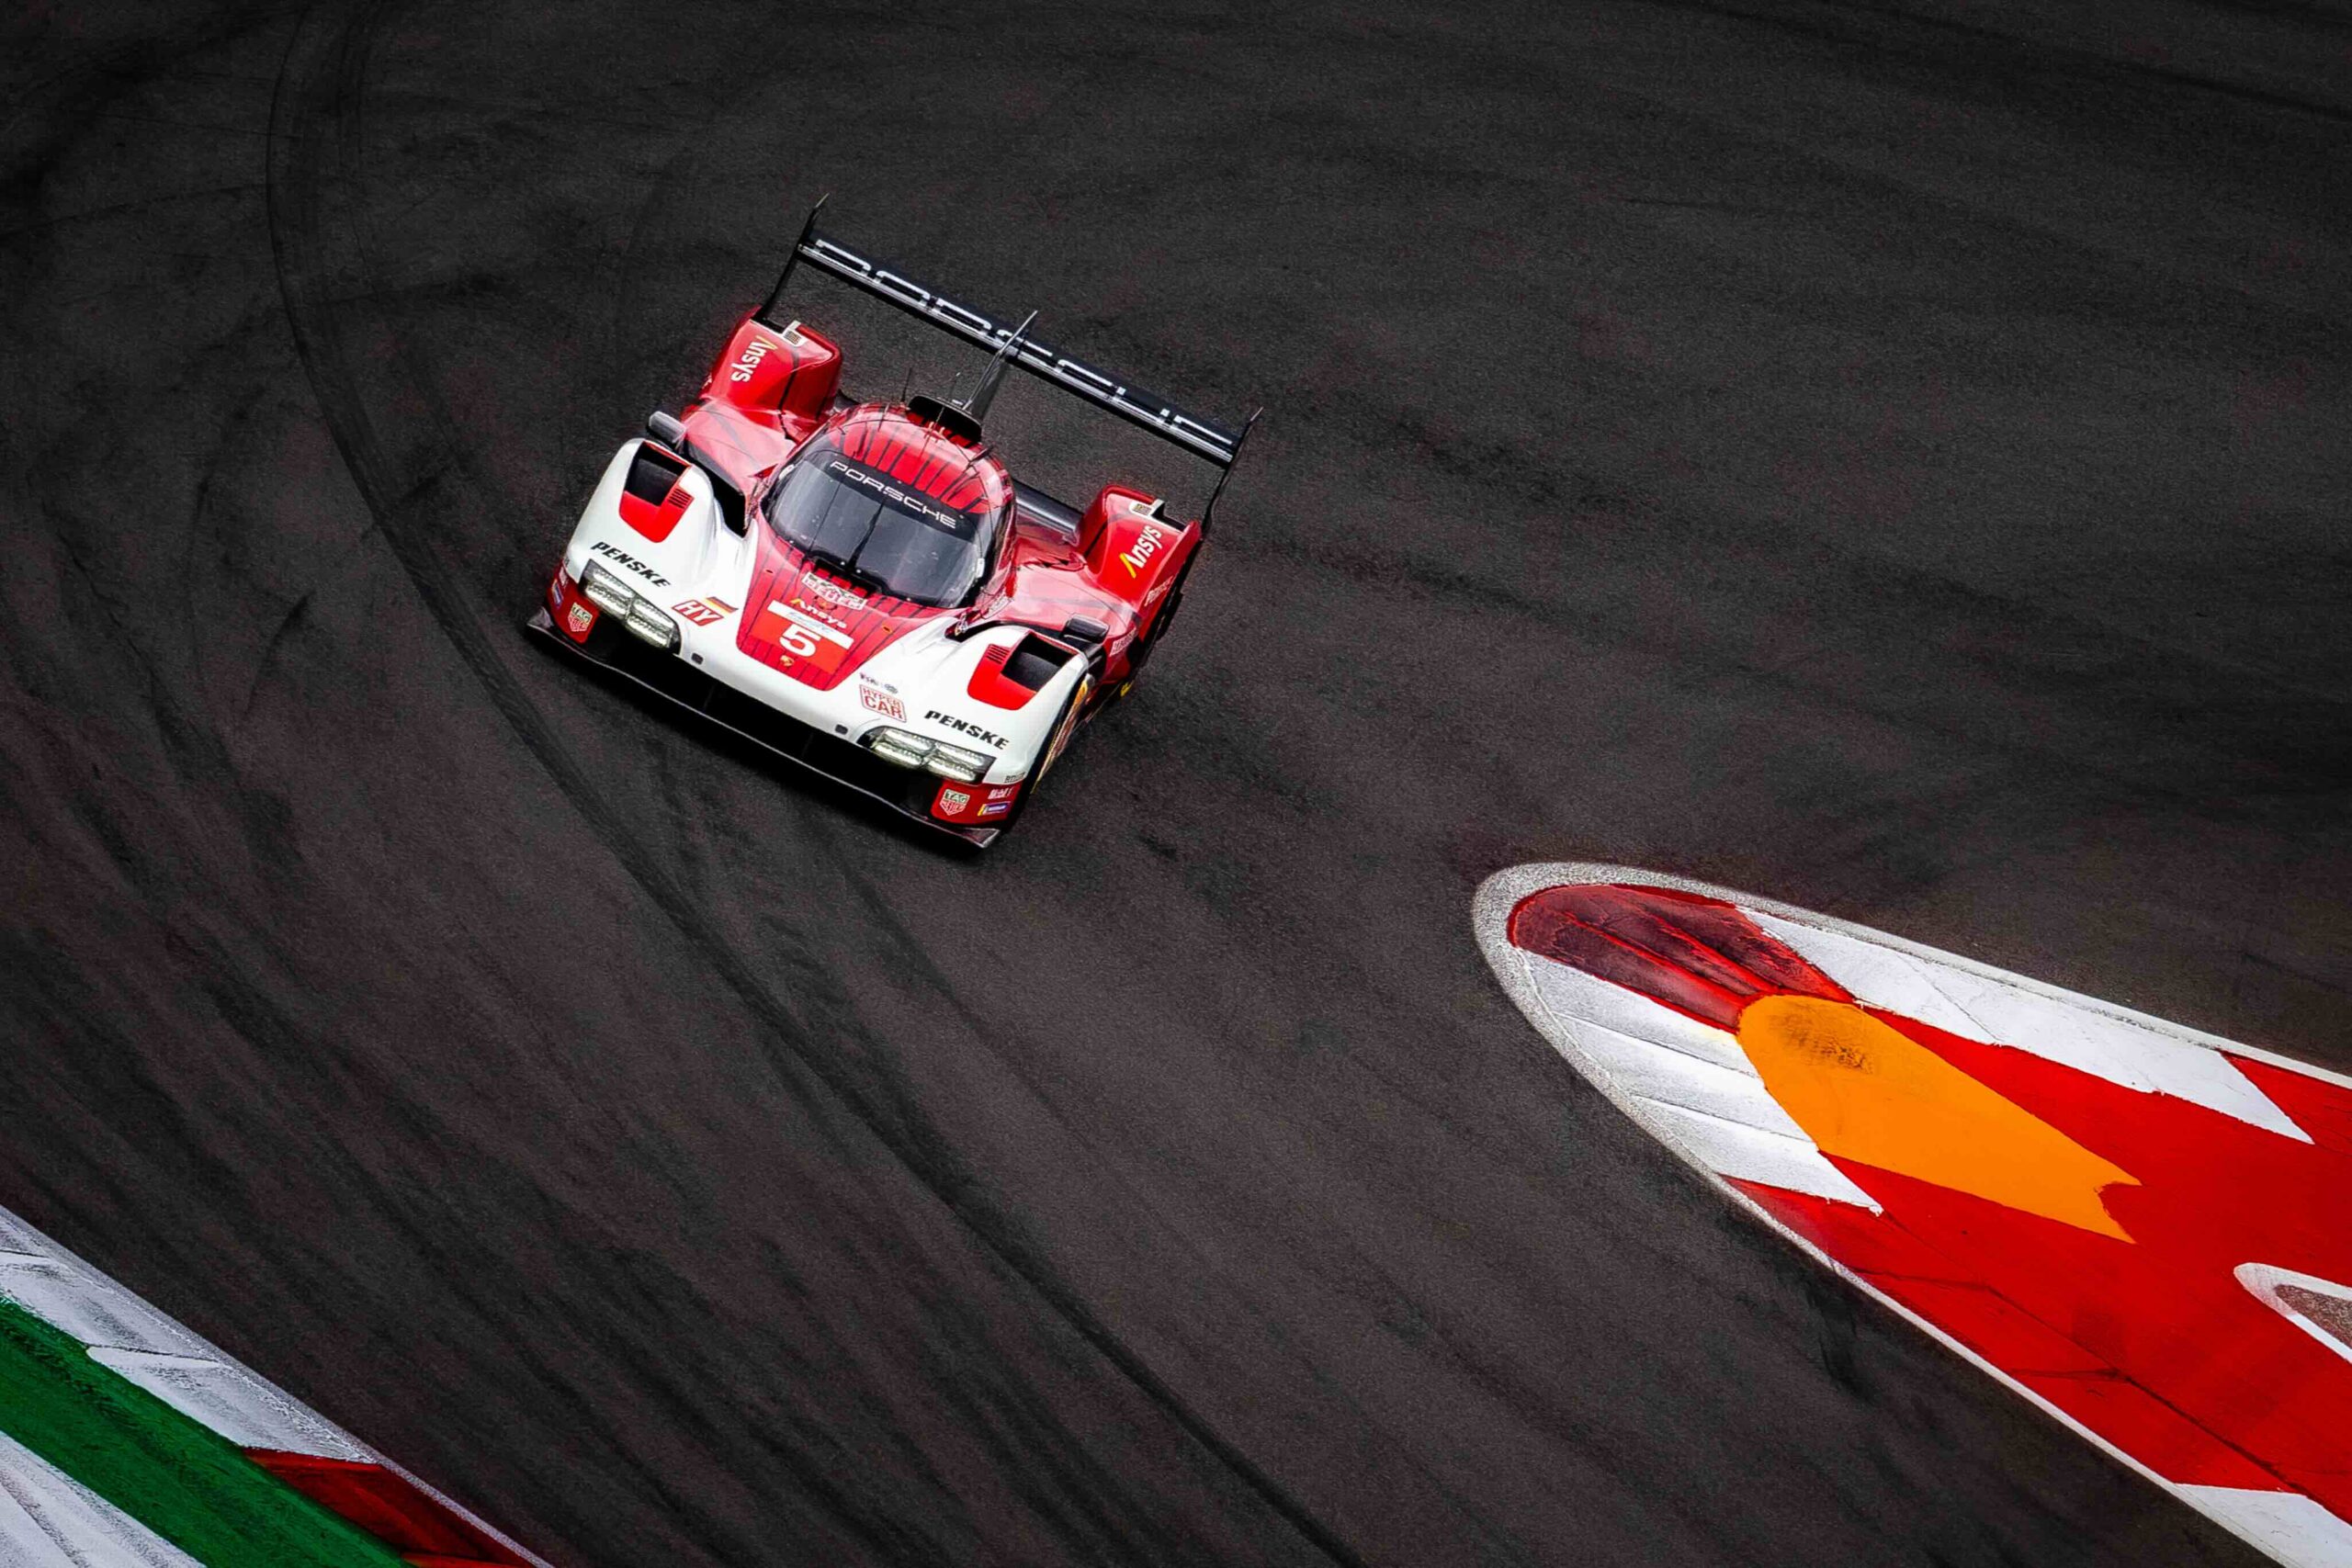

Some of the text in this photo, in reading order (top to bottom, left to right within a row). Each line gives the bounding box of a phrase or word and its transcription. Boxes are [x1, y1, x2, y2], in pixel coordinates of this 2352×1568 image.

[730, 334, 778, 382] Ansys
[830, 460, 956, 529] PORSCHE
[591, 541, 671, 588] PENSKE
[1119, 525, 1162, 579] Ansys
[676, 600, 718, 625] HY
[789, 598, 847, 628] Ansys
[779, 624, 816, 657] 5
[865, 695, 902, 718] CAR
[924, 710, 1009, 750] PENSKE
[945, 791, 969, 803] TAG
